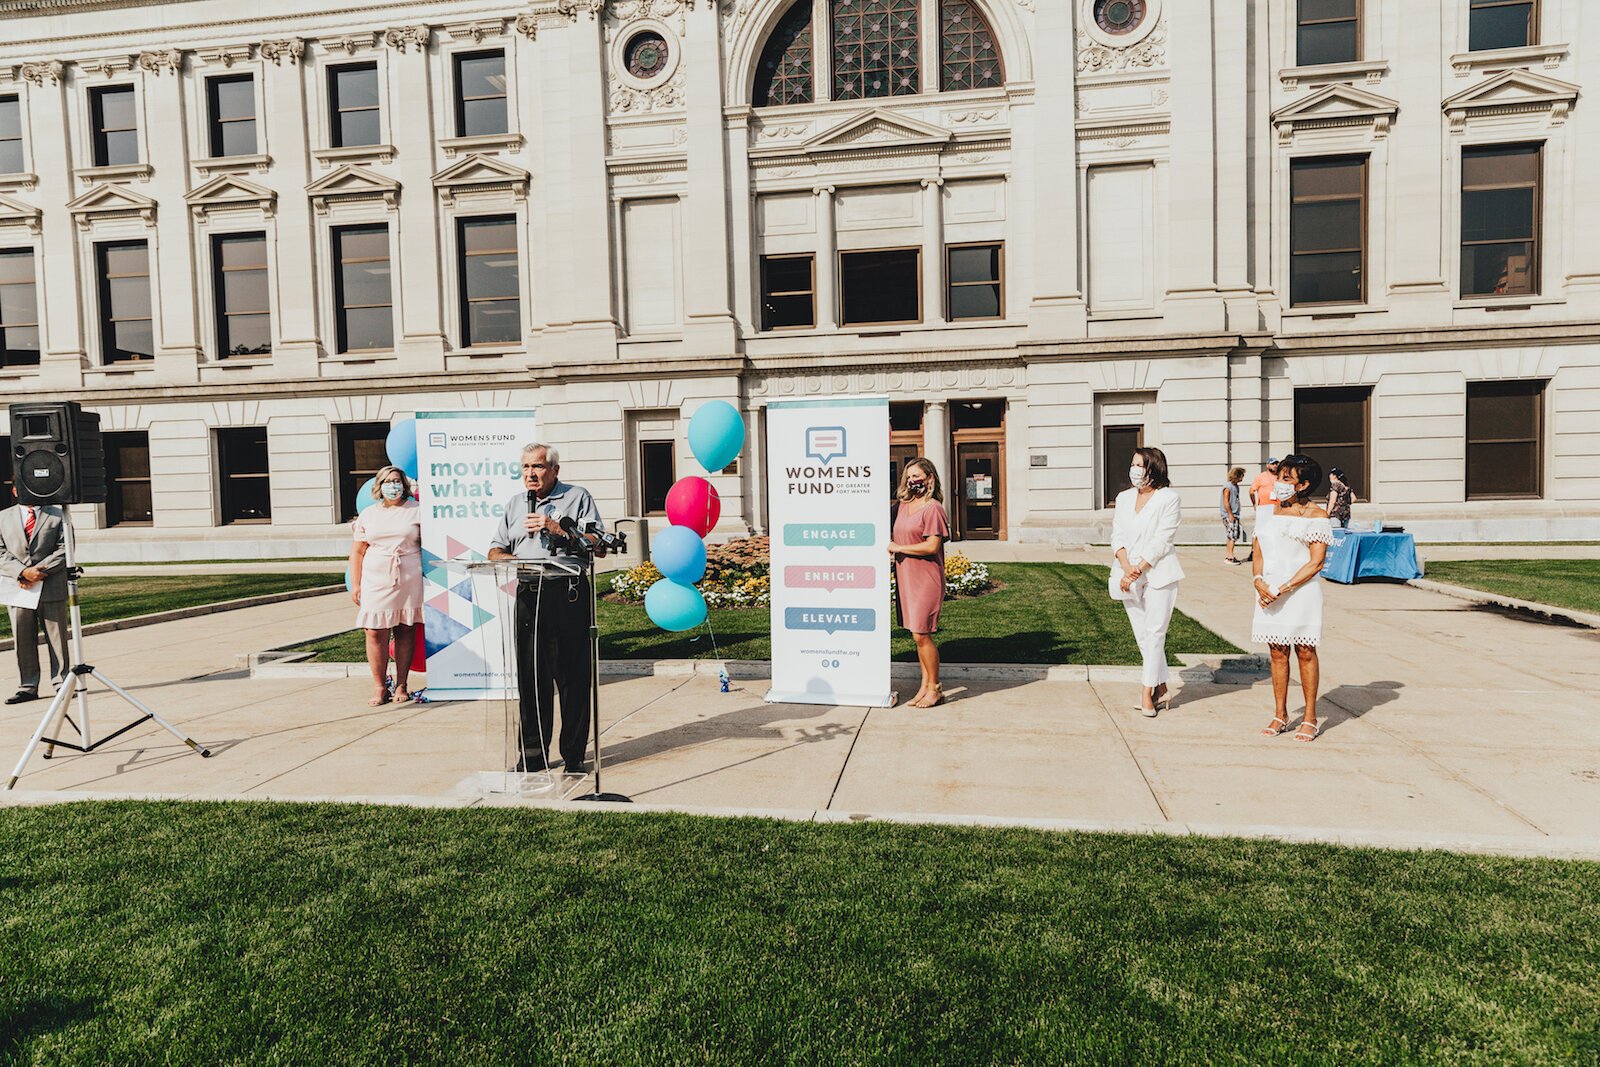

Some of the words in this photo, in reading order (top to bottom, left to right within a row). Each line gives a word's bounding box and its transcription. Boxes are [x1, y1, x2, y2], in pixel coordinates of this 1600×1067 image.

[431, 457, 522, 480] moving
[786, 466, 871, 479] WOMEN'S
[431, 479, 493, 497] what
[788, 483, 834, 494] FUND
[803, 530, 856, 539] ENGAGE
[805, 572, 854, 581] ENRICH
[803, 614, 858, 624] ELEVATE
